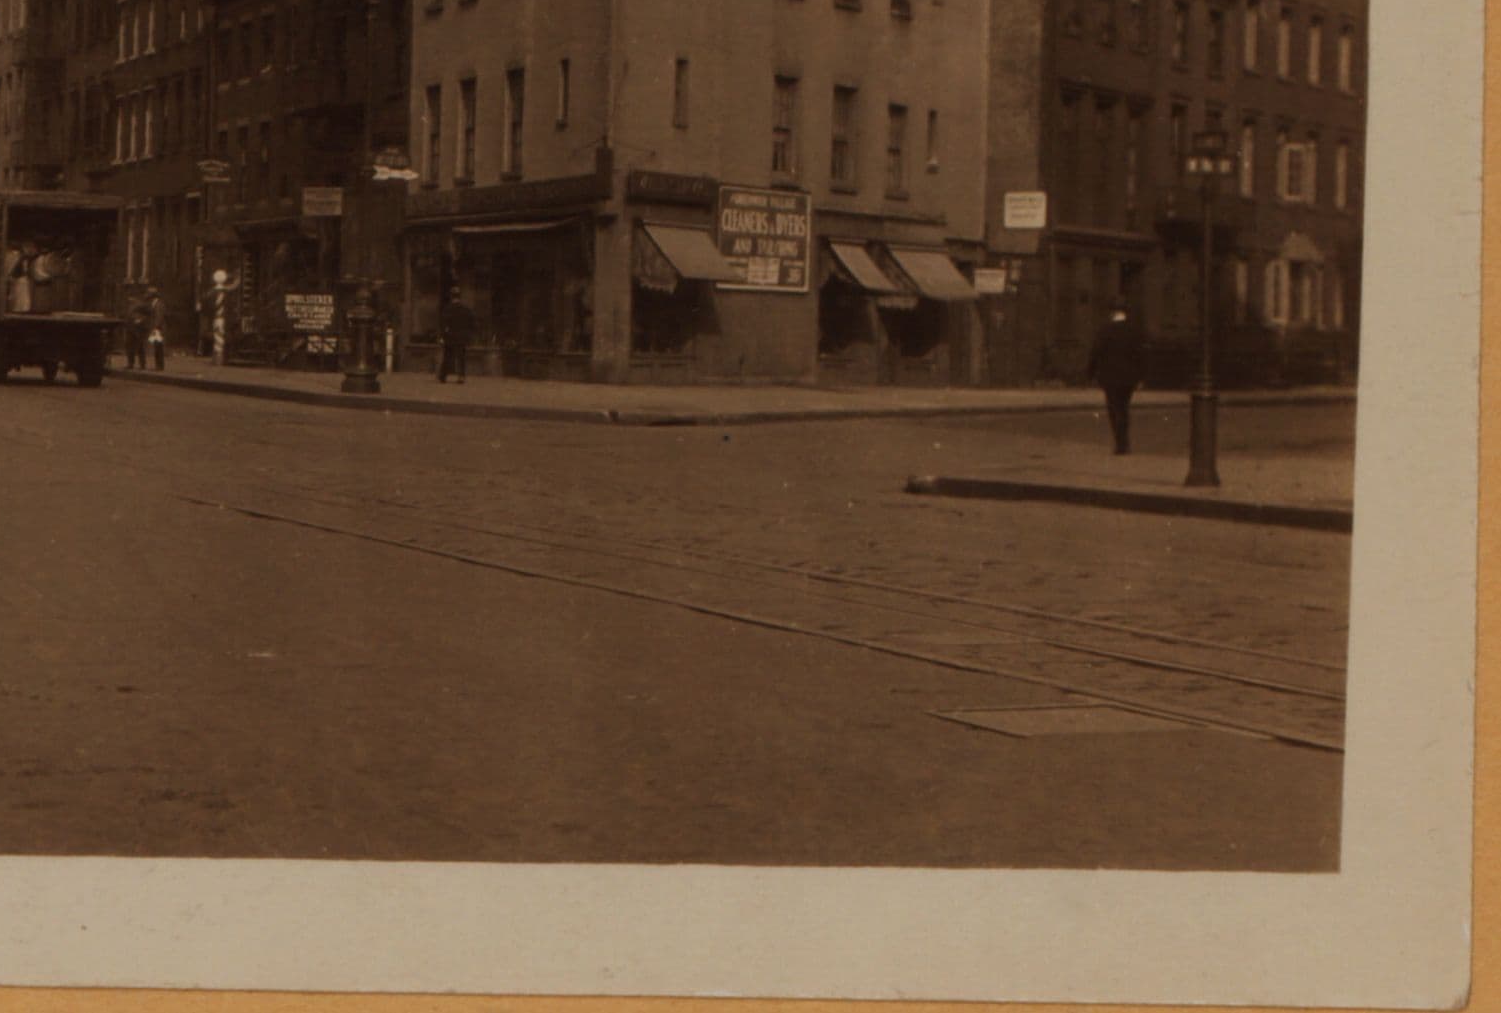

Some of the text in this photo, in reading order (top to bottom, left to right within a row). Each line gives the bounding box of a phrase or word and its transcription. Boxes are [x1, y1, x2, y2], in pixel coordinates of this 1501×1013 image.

[722, 208, 768, 234] CLEANERS
[776, 213, 805, 236] DYERS
[733, 238, 752, 254] AND
